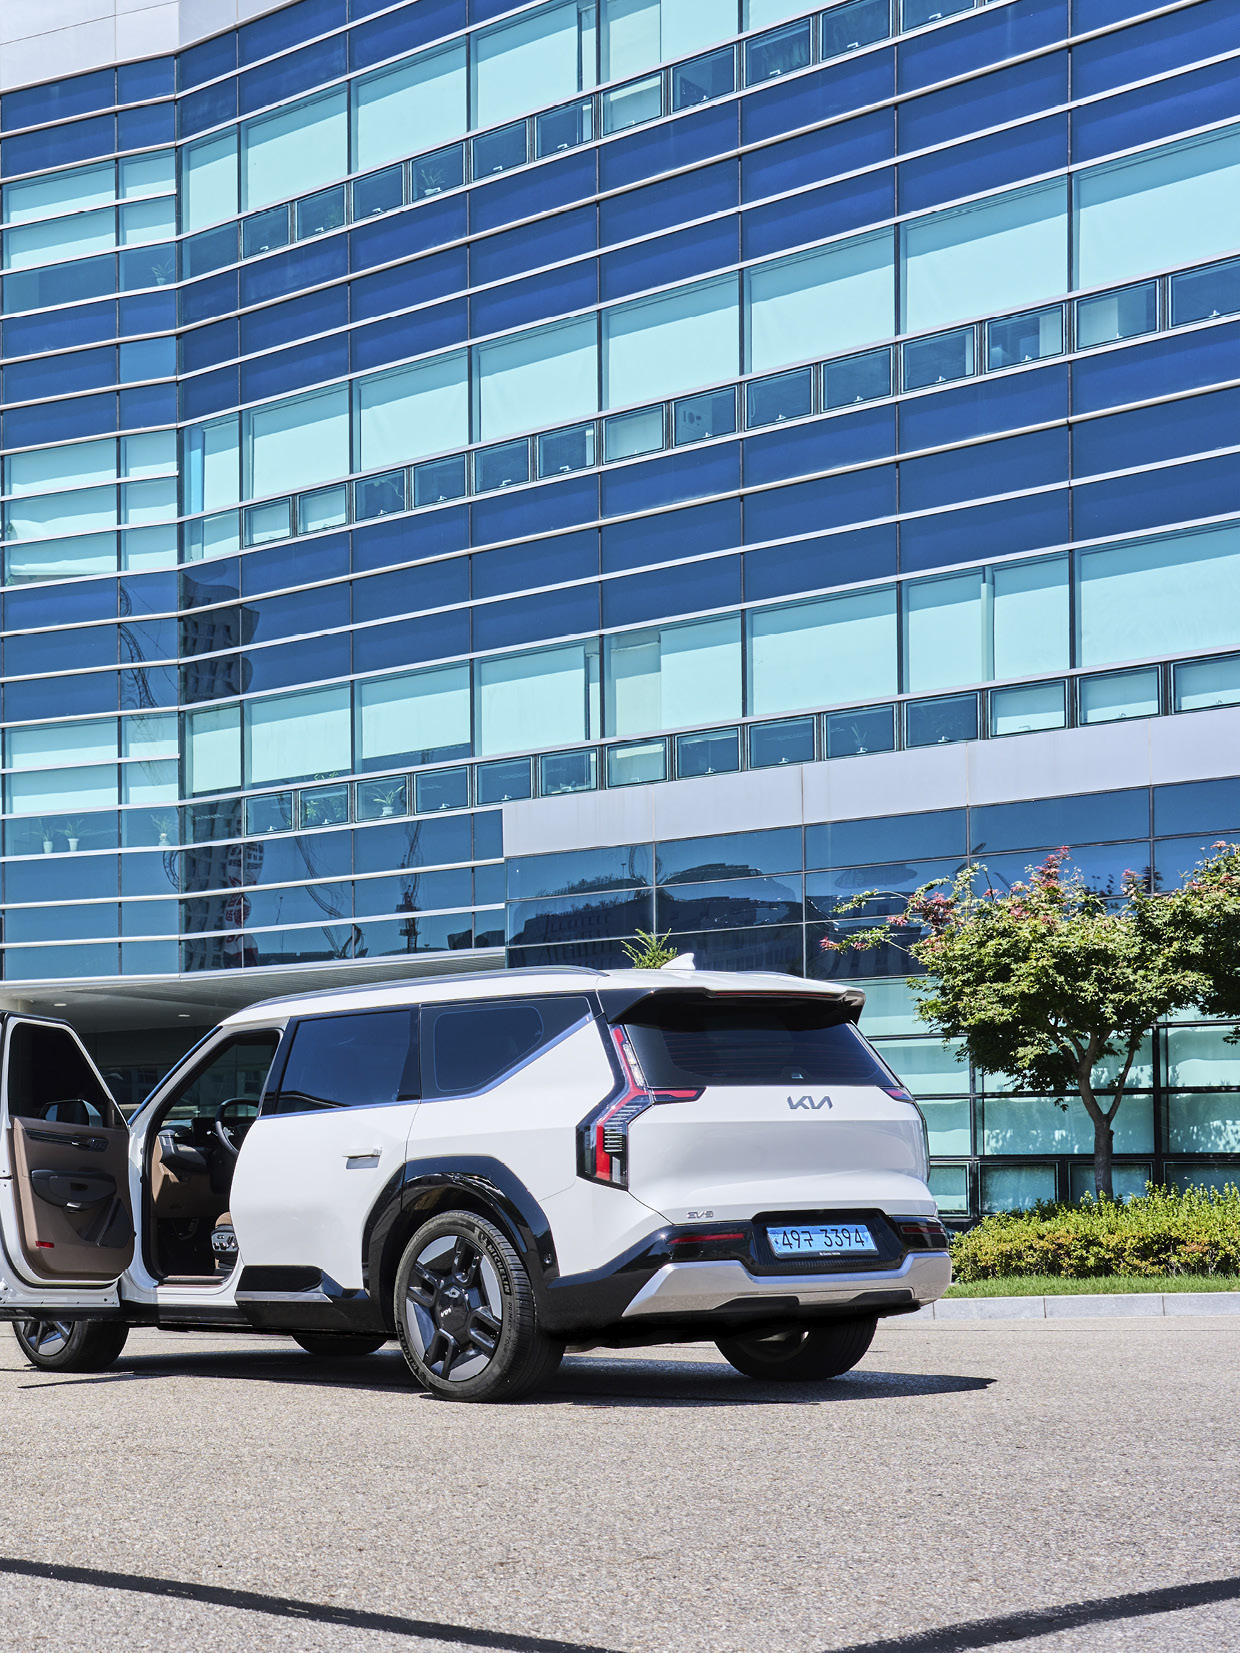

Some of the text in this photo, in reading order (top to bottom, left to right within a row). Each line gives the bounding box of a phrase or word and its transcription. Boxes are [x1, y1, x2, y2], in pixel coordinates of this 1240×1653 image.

[787, 1095, 833, 1110] KIA
[686, 1210, 714, 1219] EV9
[820, 1228, 865, 1247] 3394
[486, 1244, 512, 1295] MICHELIN
